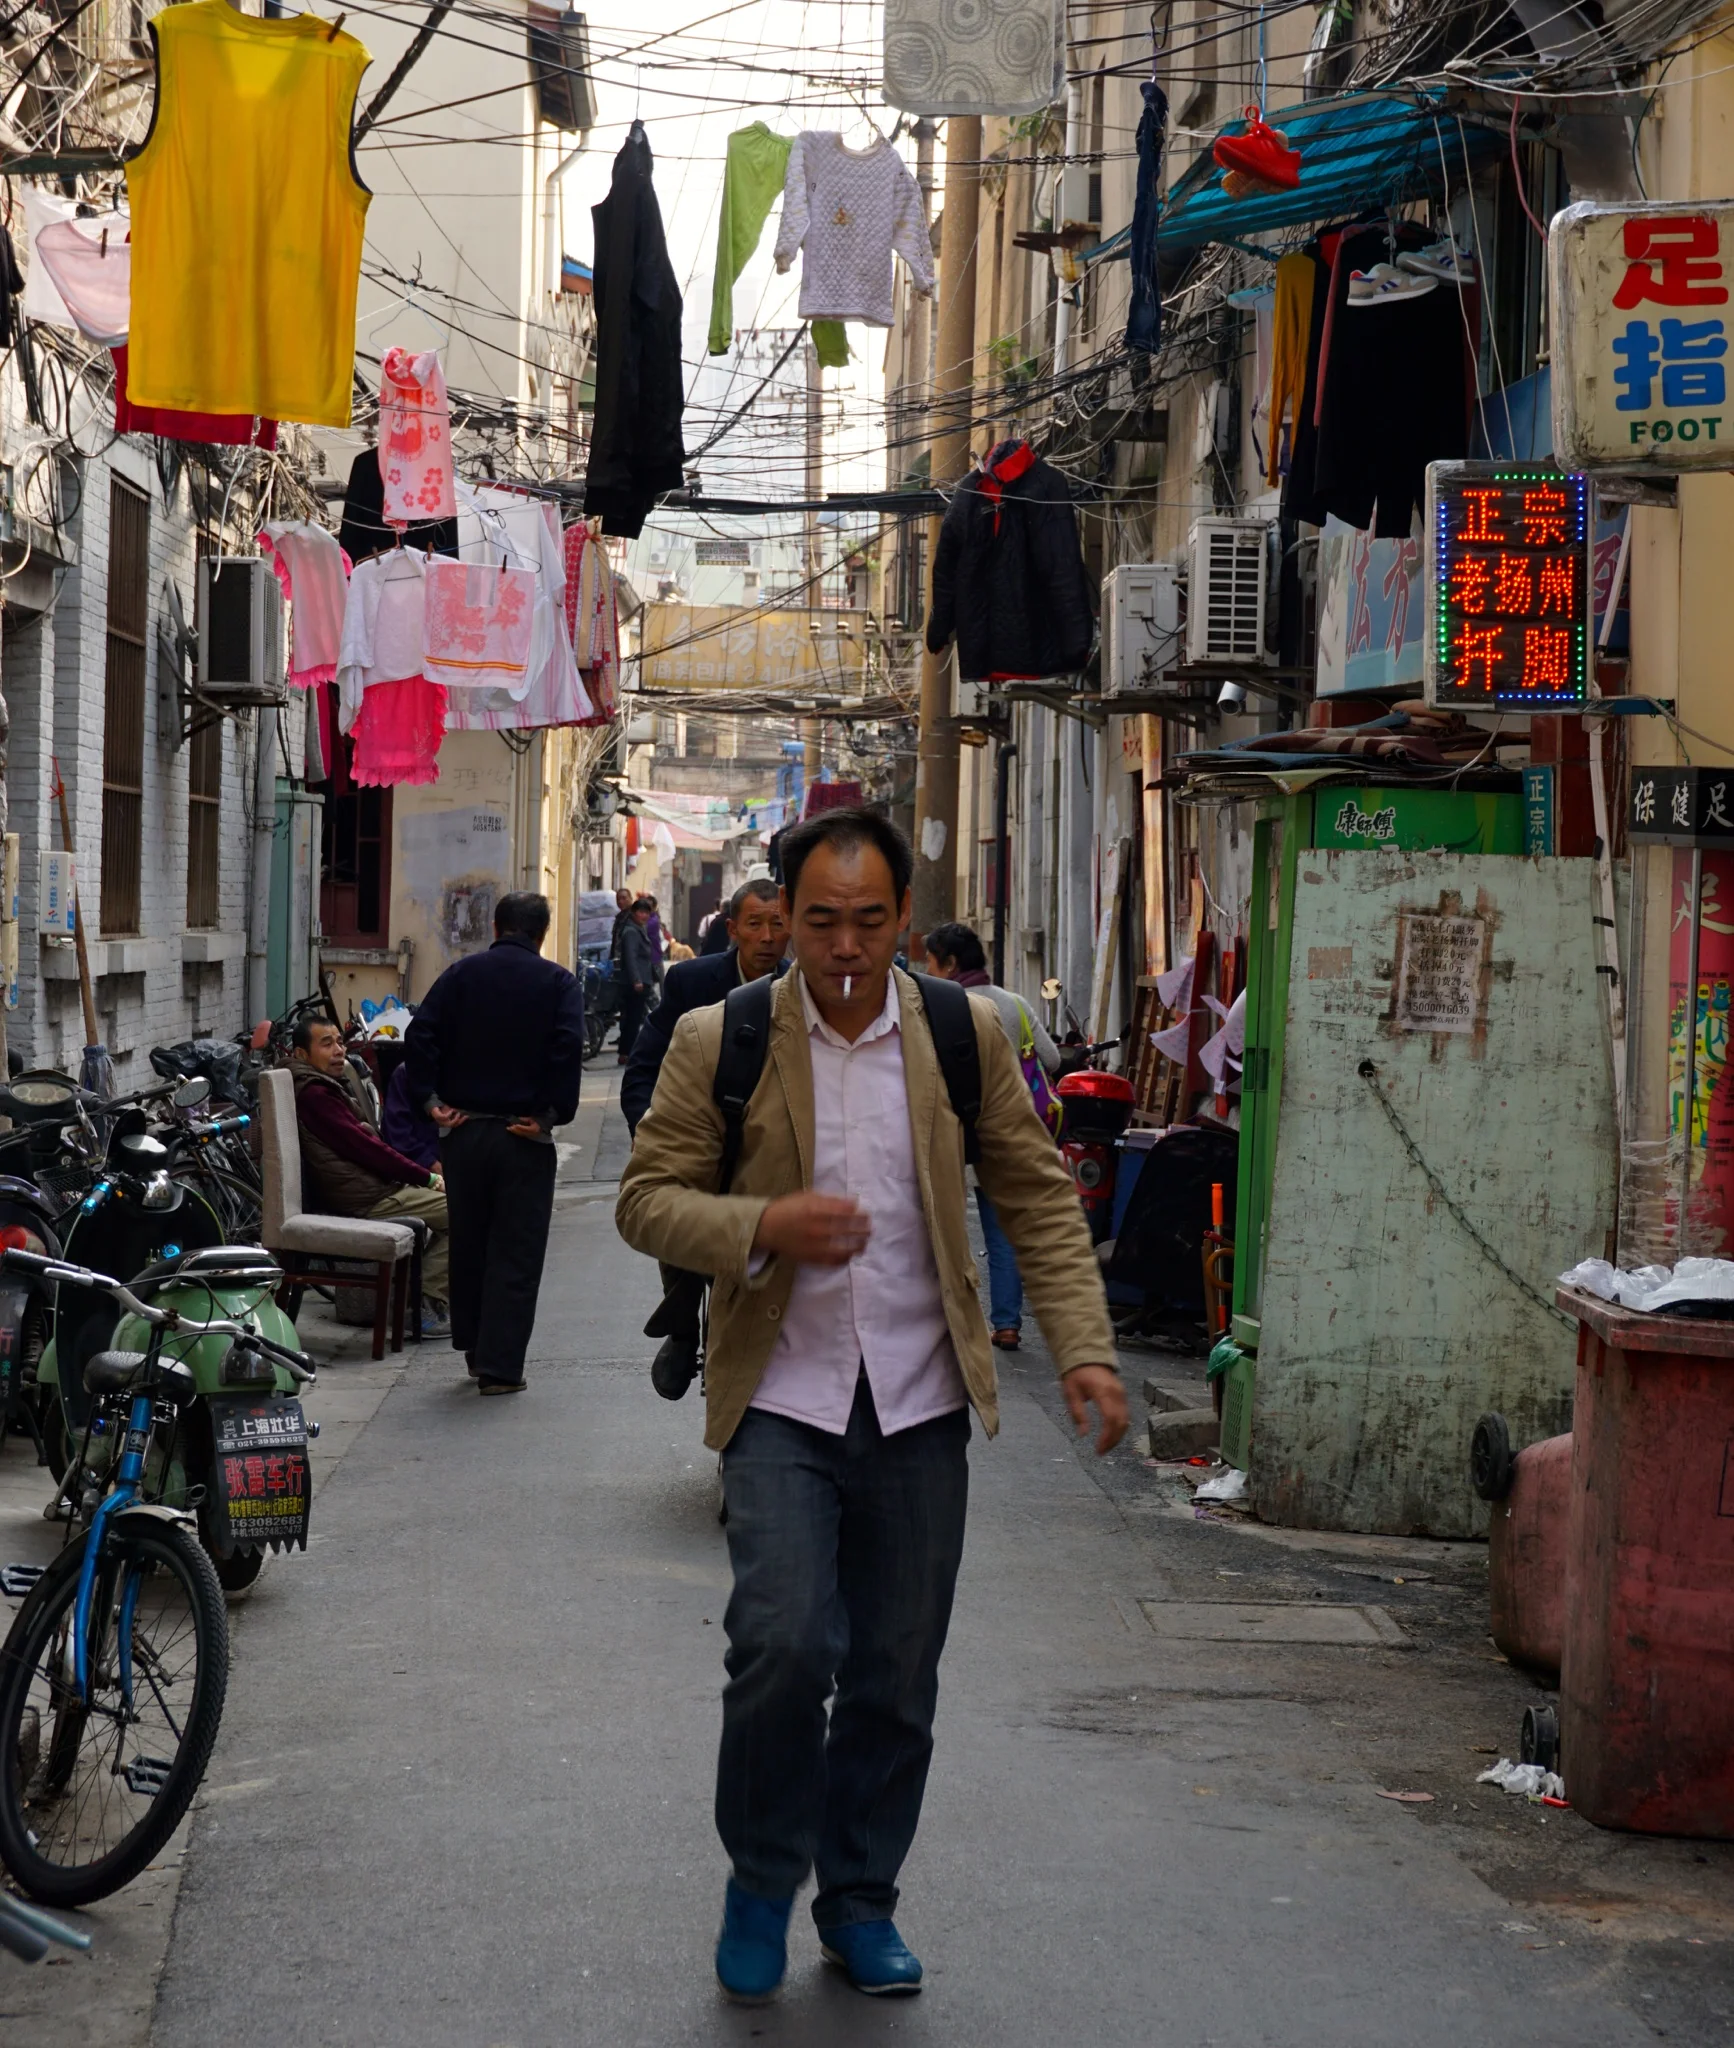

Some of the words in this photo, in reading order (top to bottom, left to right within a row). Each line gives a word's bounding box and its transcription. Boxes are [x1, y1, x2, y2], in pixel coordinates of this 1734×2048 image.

[1612, 217, 1729, 310] 足
[1612, 318, 1728, 411] 指
[1630, 417, 1722, 444] FOOT
[1458, 484, 1565, 544] 正宗
[1451, 553, 1574, 619] 老扬州
[1455, 621, 1571, 691] 扦脚
[1335, 801, 1394, 839] 康師傅
[1633, 780, 1734, 827] 保健足
[1407, 1002, 1470, 1015] 15000016039
[238, 1435, 304, 1448] 021-39598622
[224, 1453, 304, 1498] 张雷车行
[230, 1516, 303, 1529] T:63082683
